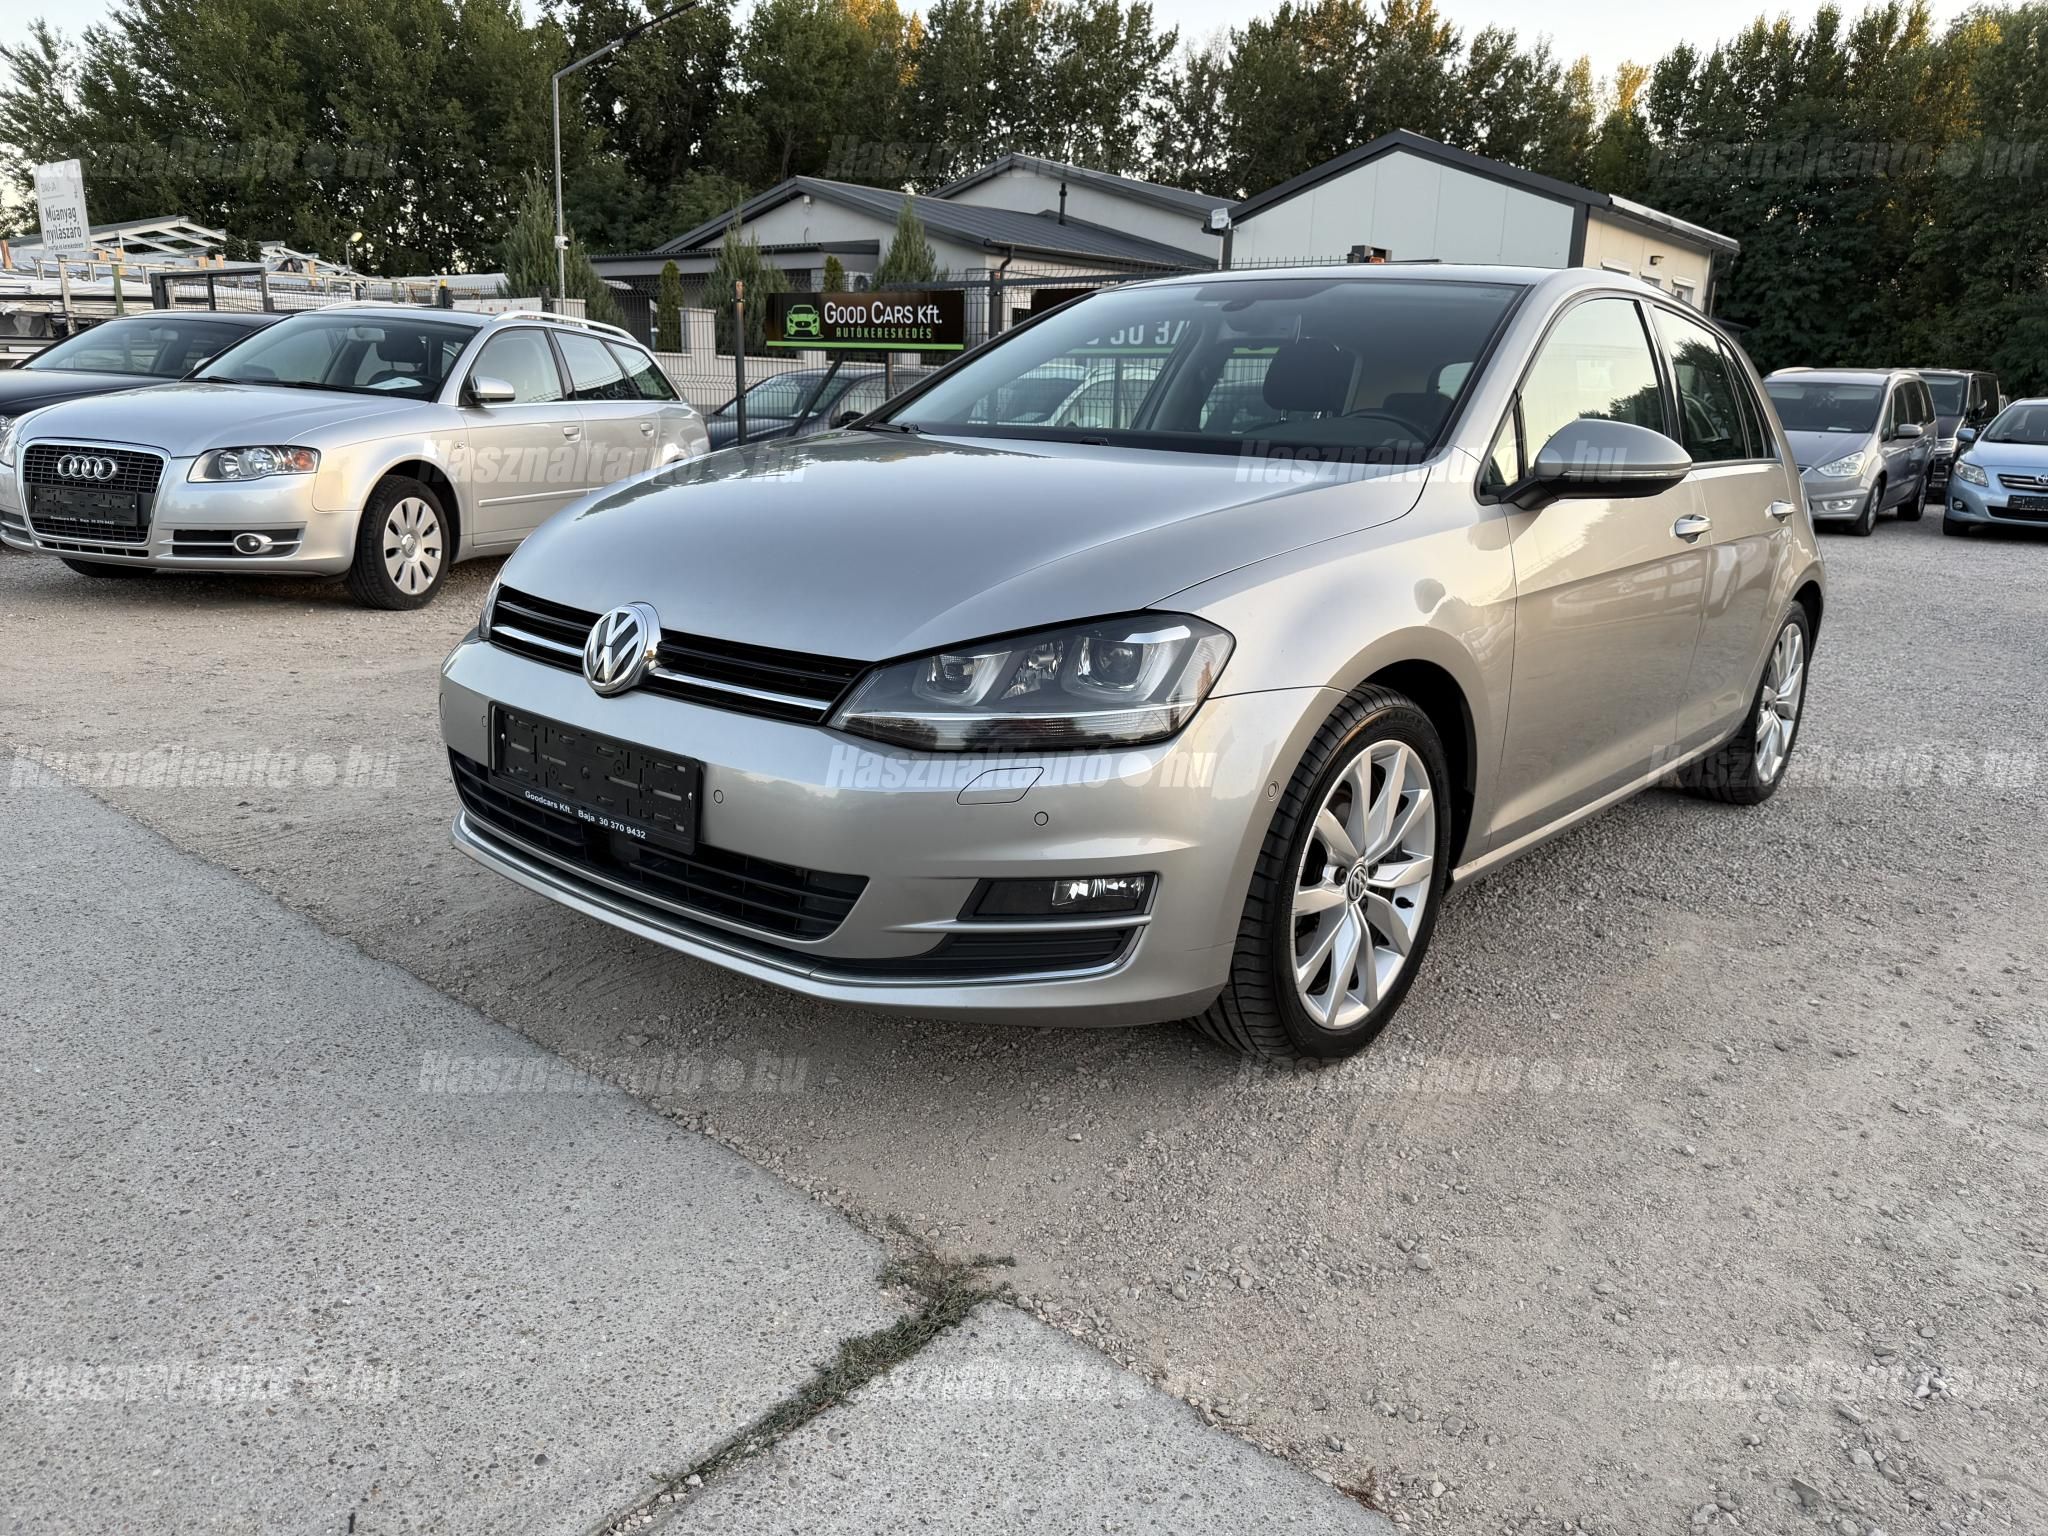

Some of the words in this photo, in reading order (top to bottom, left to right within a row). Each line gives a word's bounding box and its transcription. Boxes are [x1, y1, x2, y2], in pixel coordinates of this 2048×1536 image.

[45, 205, 77, 223] Műanyag
[824, 302, 866, 324] GOOD
[871, 301, 914, 324] CARS
[917, 304, 943, 324] Kft.
[835, 325, 933, 340] AUTÓKERESKEDÉS
[524, 790, 558, 810] Goodcars
[577, 809, 596, 823] Baja
[599, 816, 609, 827] 30
[610, 819, 625, 832] 370
[626, 824, 647, 839] 9432
